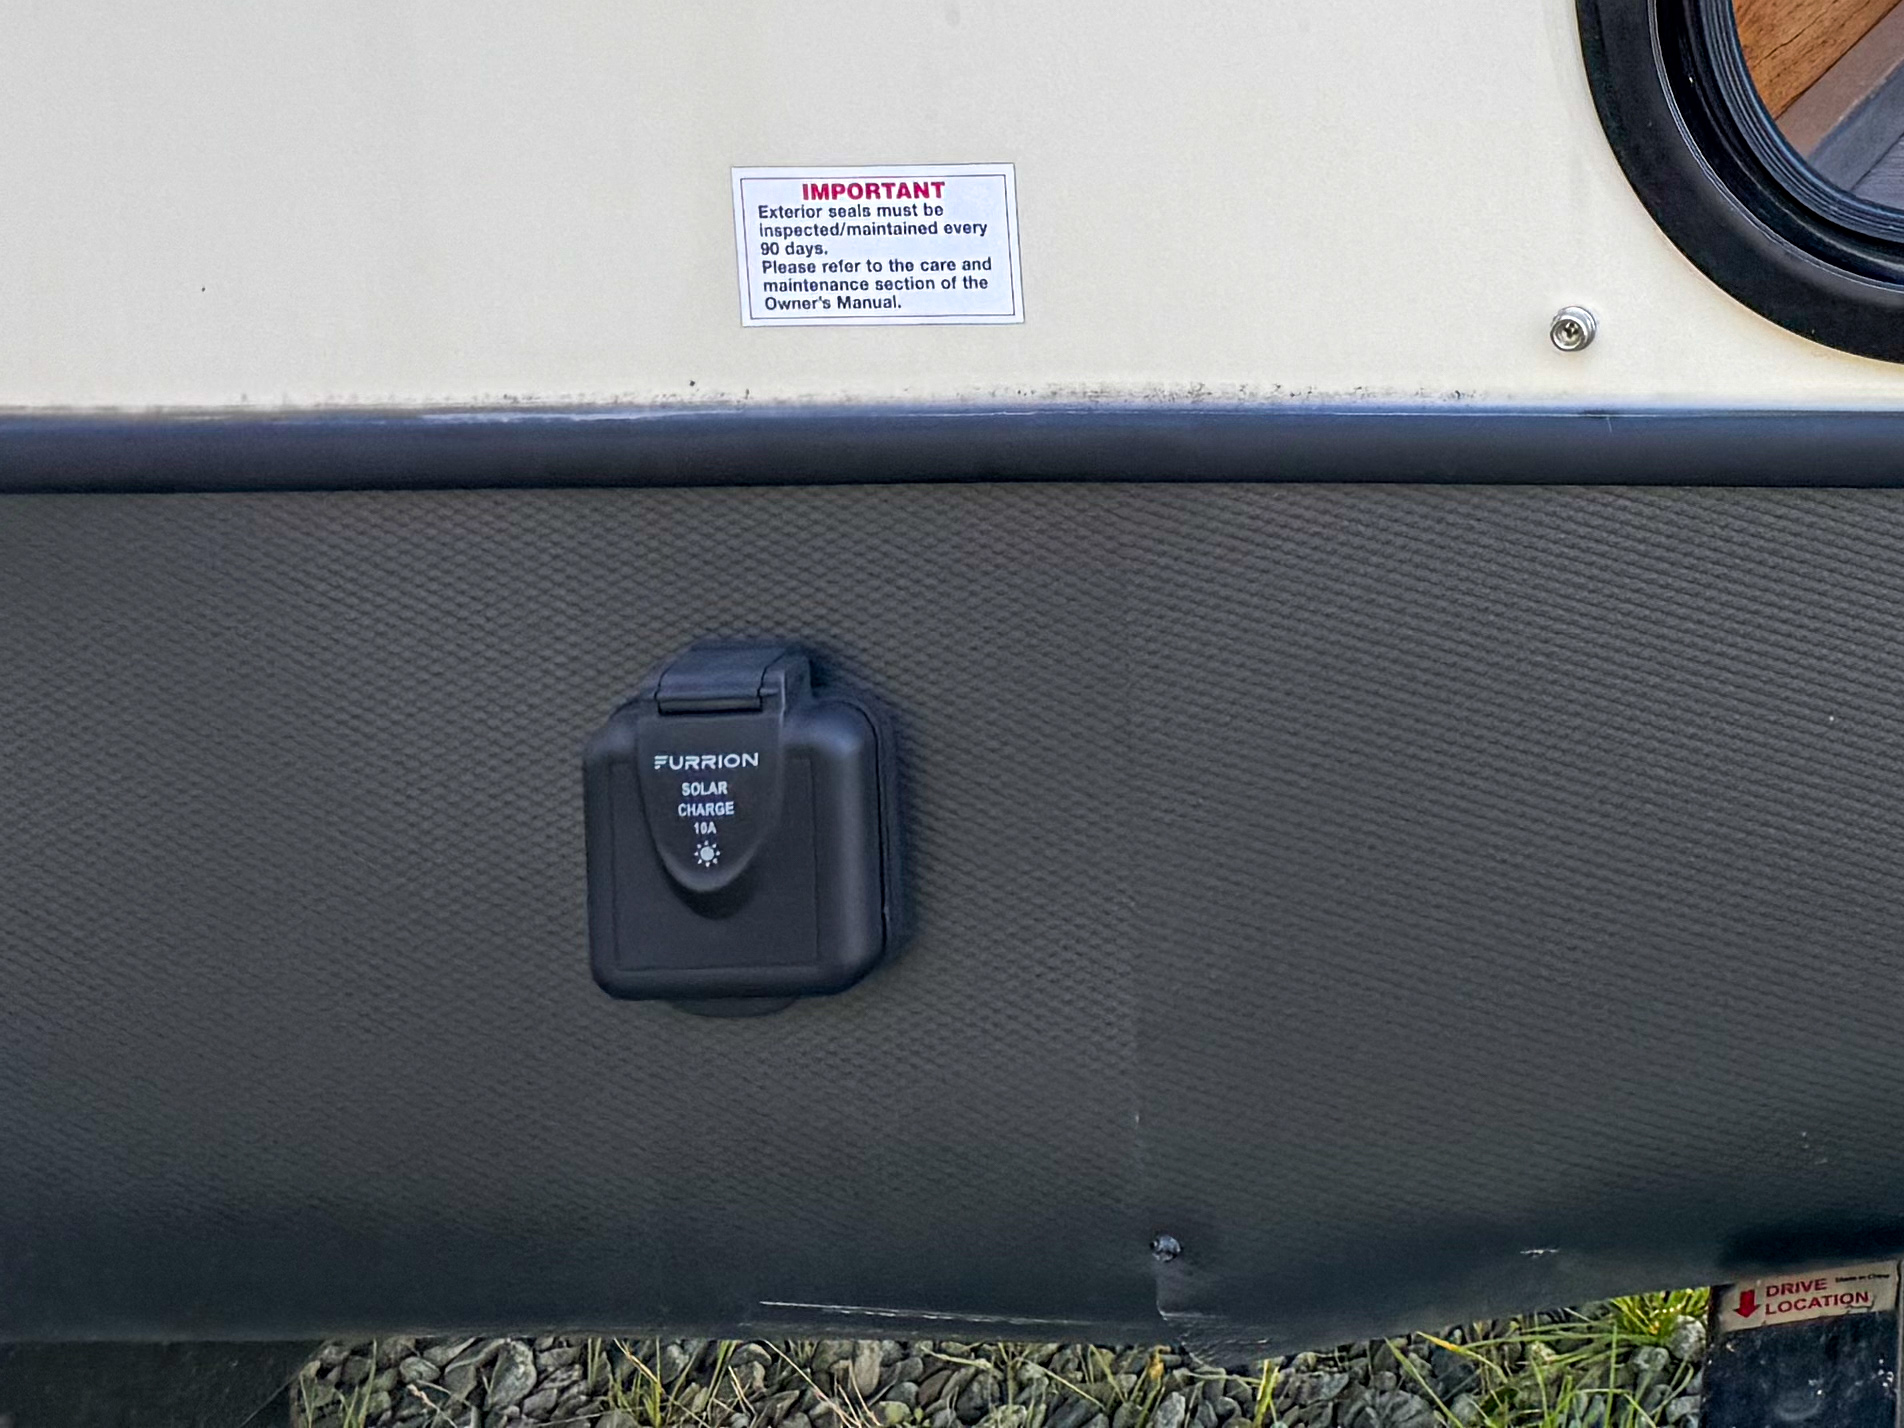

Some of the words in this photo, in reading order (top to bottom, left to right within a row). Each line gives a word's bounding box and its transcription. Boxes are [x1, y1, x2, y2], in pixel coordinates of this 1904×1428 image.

[802, 181, 945, 201] IMPORTANT
[758, 205, 822, 219] Exterior
[828, 204, 871, 218] seals
[877, 204, 918, 217] must
[923, 202, 944, 217] be
[759, 221, 938, 240] inspected/maintained
[944, 222, 988, 237] every
[760, 242, 779, 256] 90
[785, 241, 828, 258] days.
[762, 260, 816, 274] Please
[822, 259, 861, 273] refer
[866, 259, 882, 273] to
[889, 258, 914, 272] the
[920, 259, 956, 272] care
[962, 256, 992, 271] and
[763, 278, 869, 292] maintenance
[875, 276, 935, 291] section
[941, 275, 957, 290] of
[963, 275, 988, 289] the
[765, 295, 831, 310] Owner's
[837, 294, 902, 309] Manual.
[654, 752, 759, 770] FURRION
[681, 781, 728, 796] SOLAR
[678, 801, 735, 817] CHARGE
[694, 821, 717, 835] 10A
[1766, 1278, 1827, 1297] DRIVE
[1765, 1291, 1869, 1315] LOCATION
